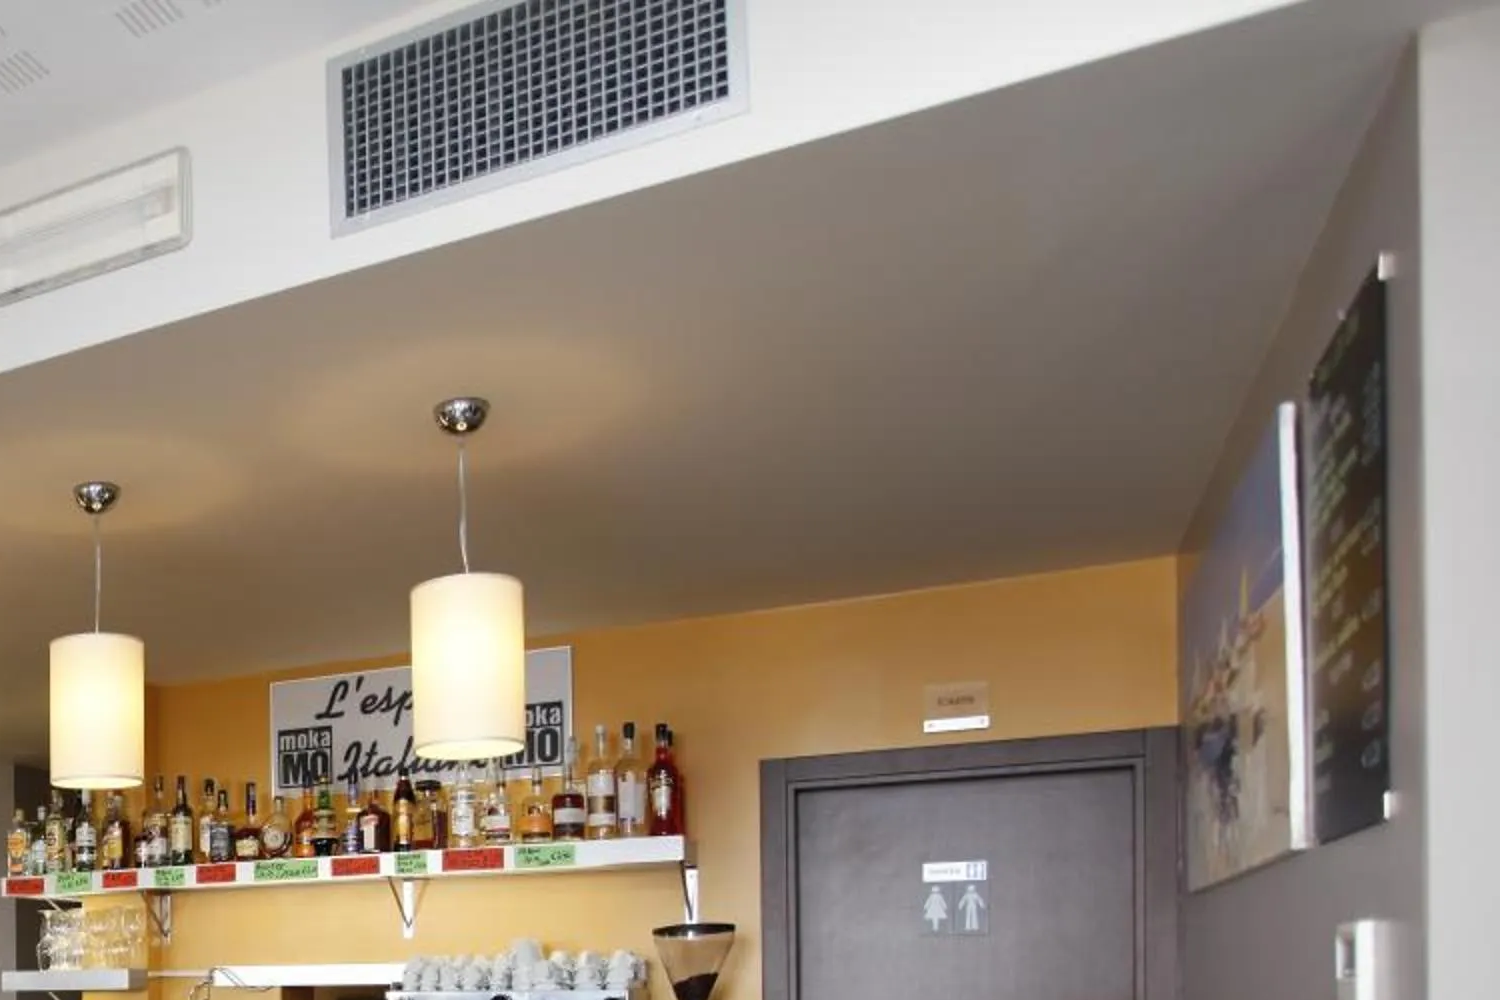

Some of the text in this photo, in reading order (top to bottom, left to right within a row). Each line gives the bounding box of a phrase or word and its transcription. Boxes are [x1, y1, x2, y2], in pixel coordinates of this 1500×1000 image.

[315, 676, 413, 725] L'esp
[524, 704, 562, 728] oka
[278, 729, 331, 751] moka
[282, 751, 330, 785] MO
[336, 736, 488, 783] Itali
